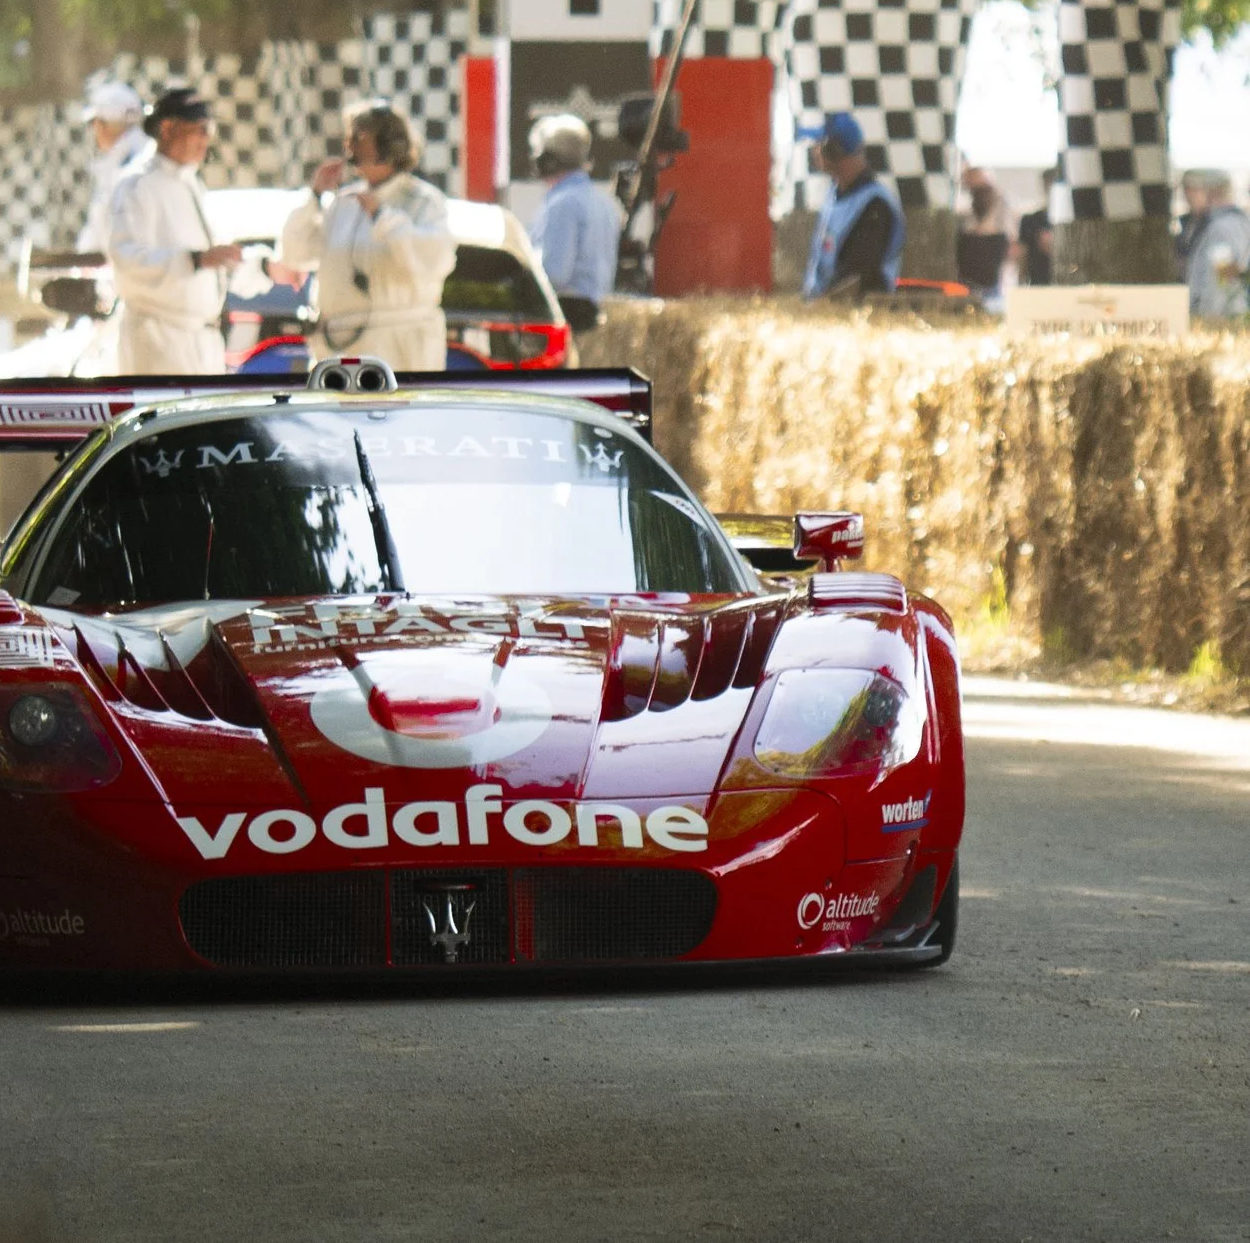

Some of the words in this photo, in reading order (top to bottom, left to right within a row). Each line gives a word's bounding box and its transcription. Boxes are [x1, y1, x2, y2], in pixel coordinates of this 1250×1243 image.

[196, 436, 567, 469] MASERATI
[177, 783, 709, 860] vodafone
[882, 795, 924, 823] worten
[825, 890, 880, 919] altitude
[10, 908, 85, 934] altitude
[822, 920, 851, 932] software
